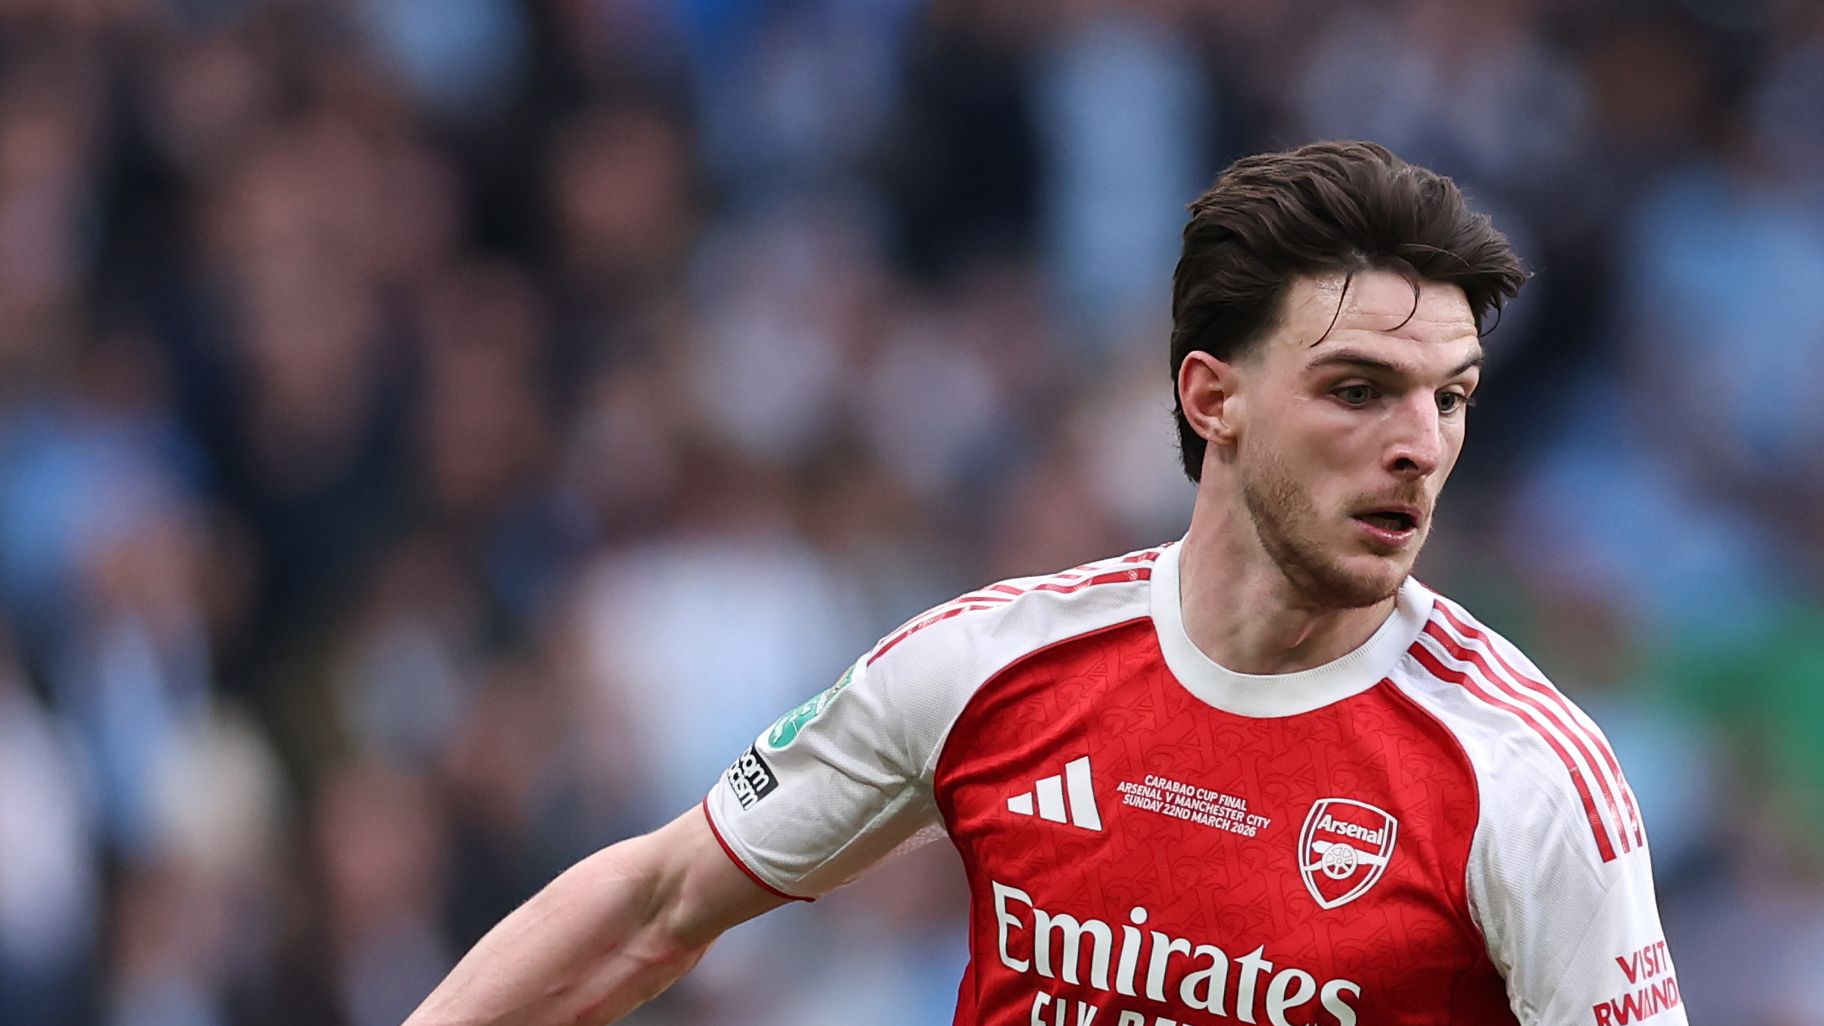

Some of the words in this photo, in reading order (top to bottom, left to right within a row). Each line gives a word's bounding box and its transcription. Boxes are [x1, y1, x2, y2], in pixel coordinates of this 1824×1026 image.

[740, 745, 770, 792] oom
[1116, 781, 1162, 801] ARSENAL
[1165, 791, 1174, 802] V
[1175, 794, 1244, 822] MANCHESTER
[1246, 813, 1271, 828] CITY
[1123, 793, 1163, 813] SUNDAY
[1162, 805, 1190, 820] 22ND
[1190, 813, 1230, 830] MARCH
[1230, 822, 1257, 837] 2026
[1144, 775, 1194, 795] CARABAO
[1196, 788, 1217, 802] CUP
[1218, 794, 1247, 811] FINAL
[1317, 814, 1384, 846] Arsenal
[1615, 940, 1667, 985] VISIT
